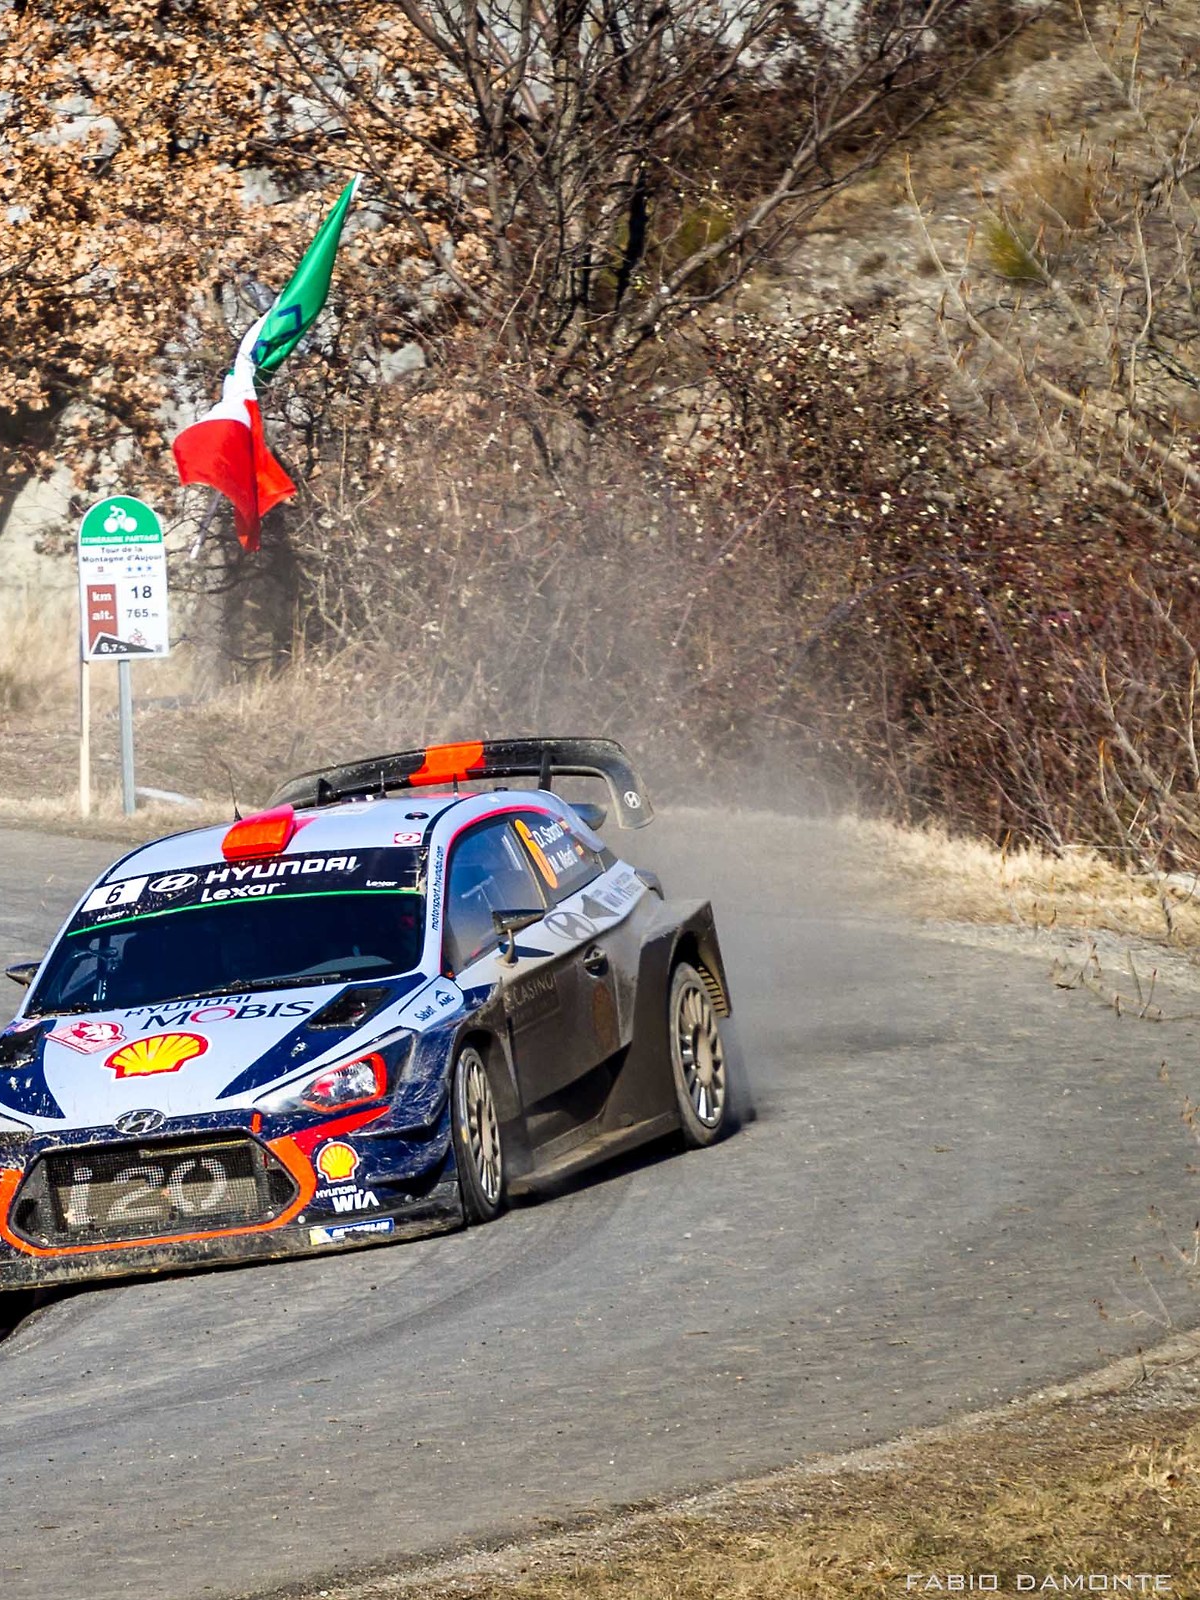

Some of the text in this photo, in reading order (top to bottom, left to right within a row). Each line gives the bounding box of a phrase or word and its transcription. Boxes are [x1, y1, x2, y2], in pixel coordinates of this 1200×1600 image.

[92, 585, 152, 602] km 18
[92, 610, 114, 621] alt.
[127, 608, 149, 618] 765
[514, 819, 558, 889] 6
[204, 856, 357, 884] HYUNDAI
[201, 884, 280, 902] Lexar
[365, 879, 398, 888] Lexar
[106, 884, 125, 904] 6
[124, 996, 253, 1018] HYUNDAI
[140, 1000, 314, 1030] MOBIS
[315, 1184, 357, 1199] HYUNDAI
